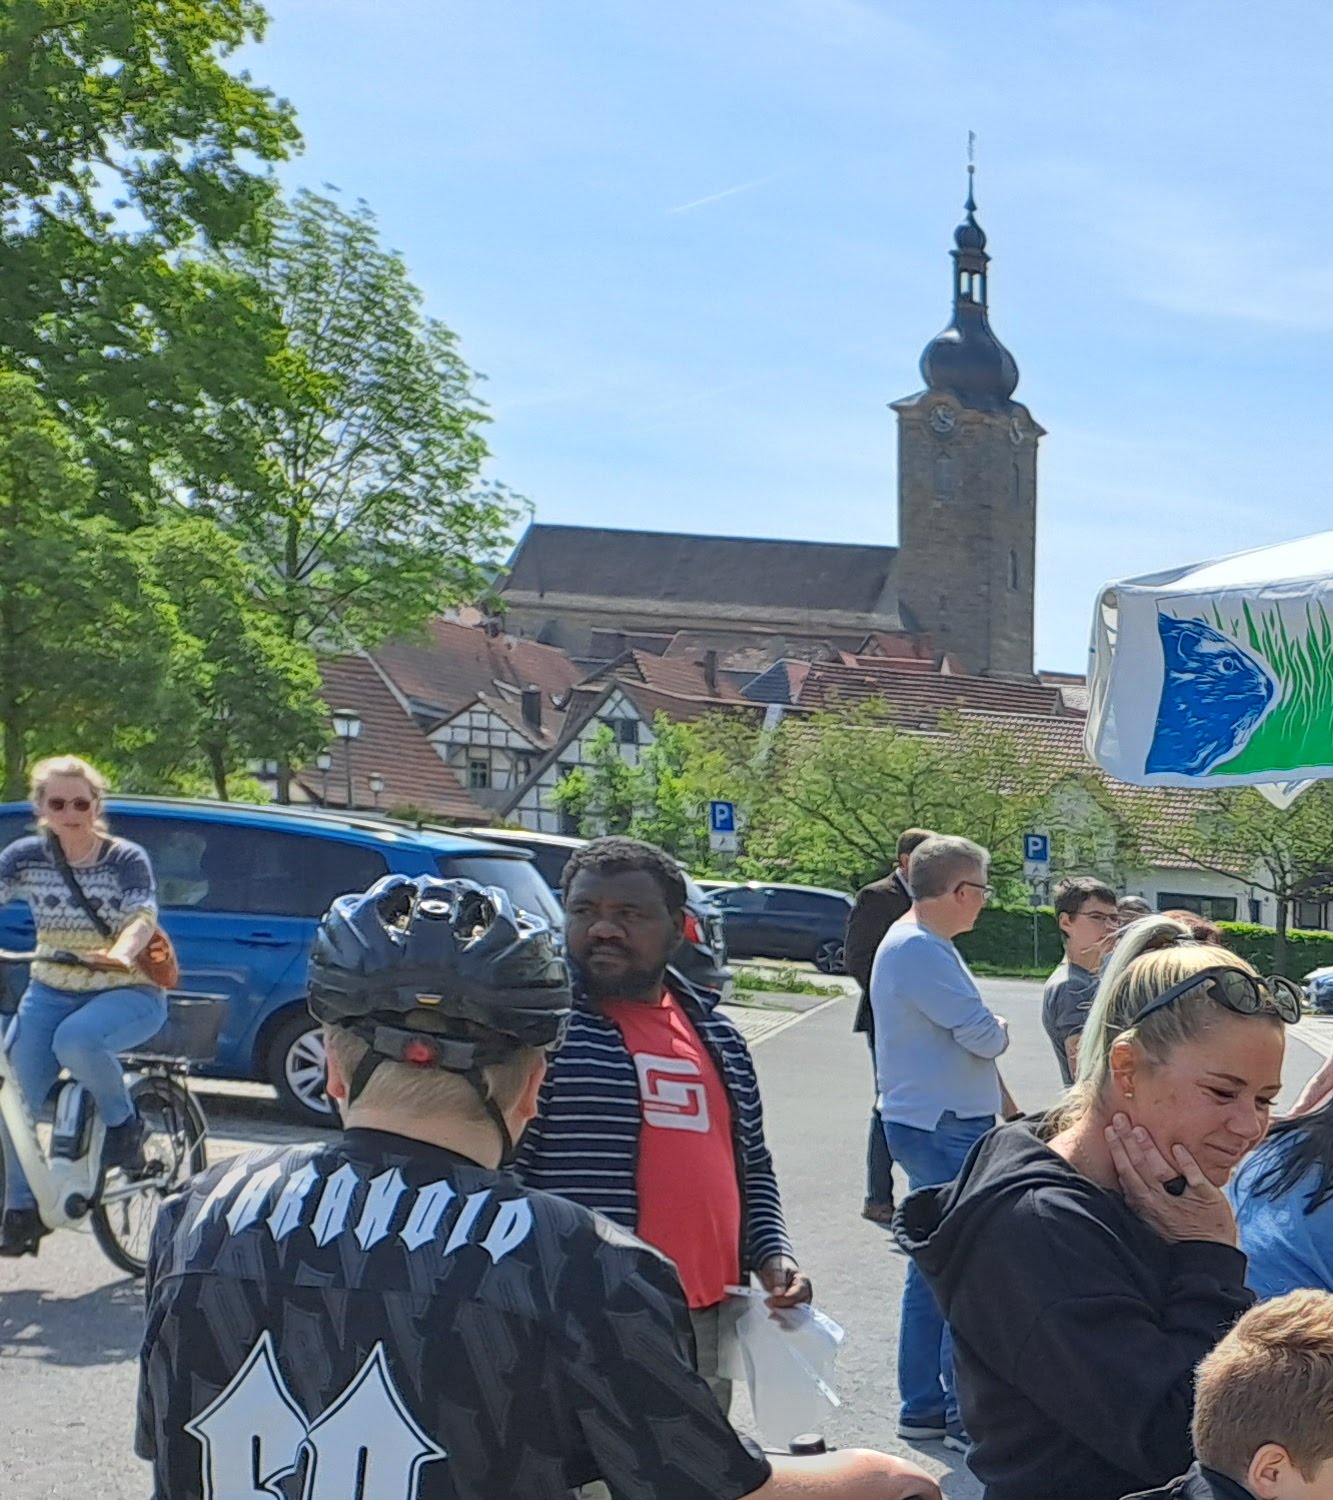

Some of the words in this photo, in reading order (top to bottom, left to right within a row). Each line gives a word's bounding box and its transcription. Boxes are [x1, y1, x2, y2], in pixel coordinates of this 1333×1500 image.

[715, 803, 730, 828] P
[1027, 836, 1042, 858] P
[189, 1159, 533, 1264] PARANOID
